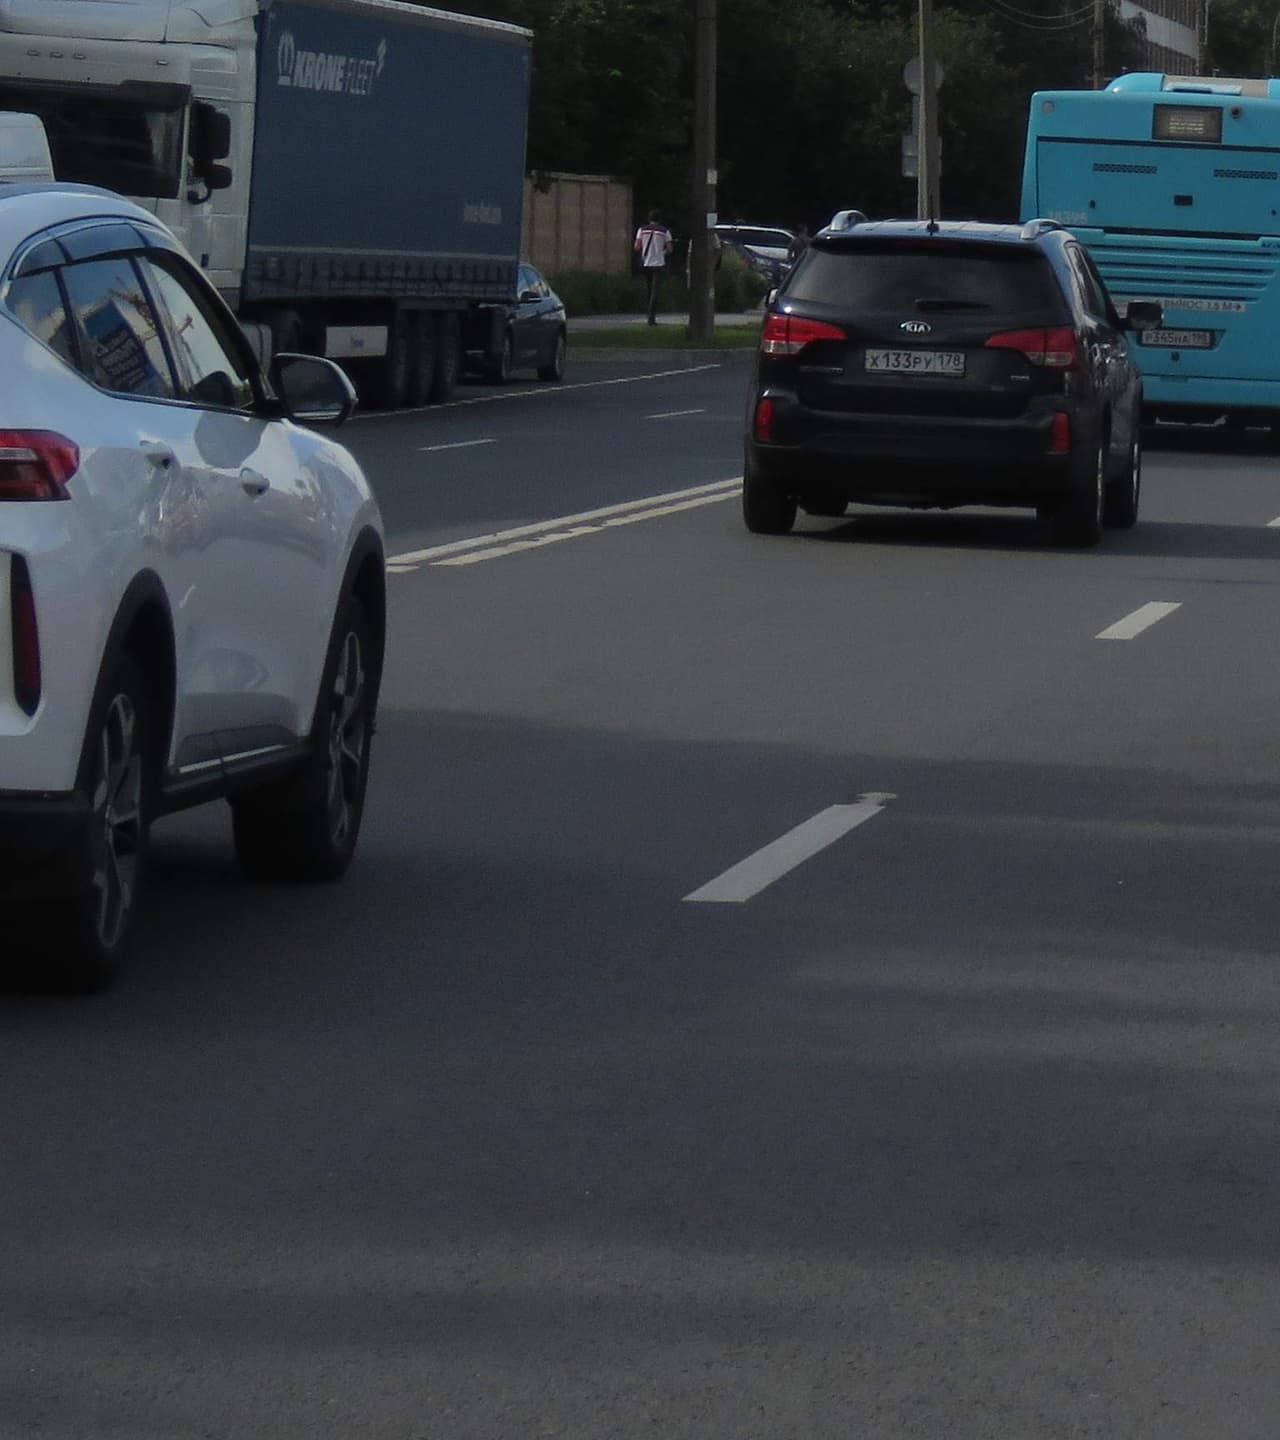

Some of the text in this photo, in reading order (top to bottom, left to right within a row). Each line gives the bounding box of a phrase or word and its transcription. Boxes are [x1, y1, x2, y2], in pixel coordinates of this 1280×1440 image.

[293, 51, 347, 91] KRONE
[906, 324, 926, 333] KIA
[869, 351, 962, 369] Х133РУ 178
